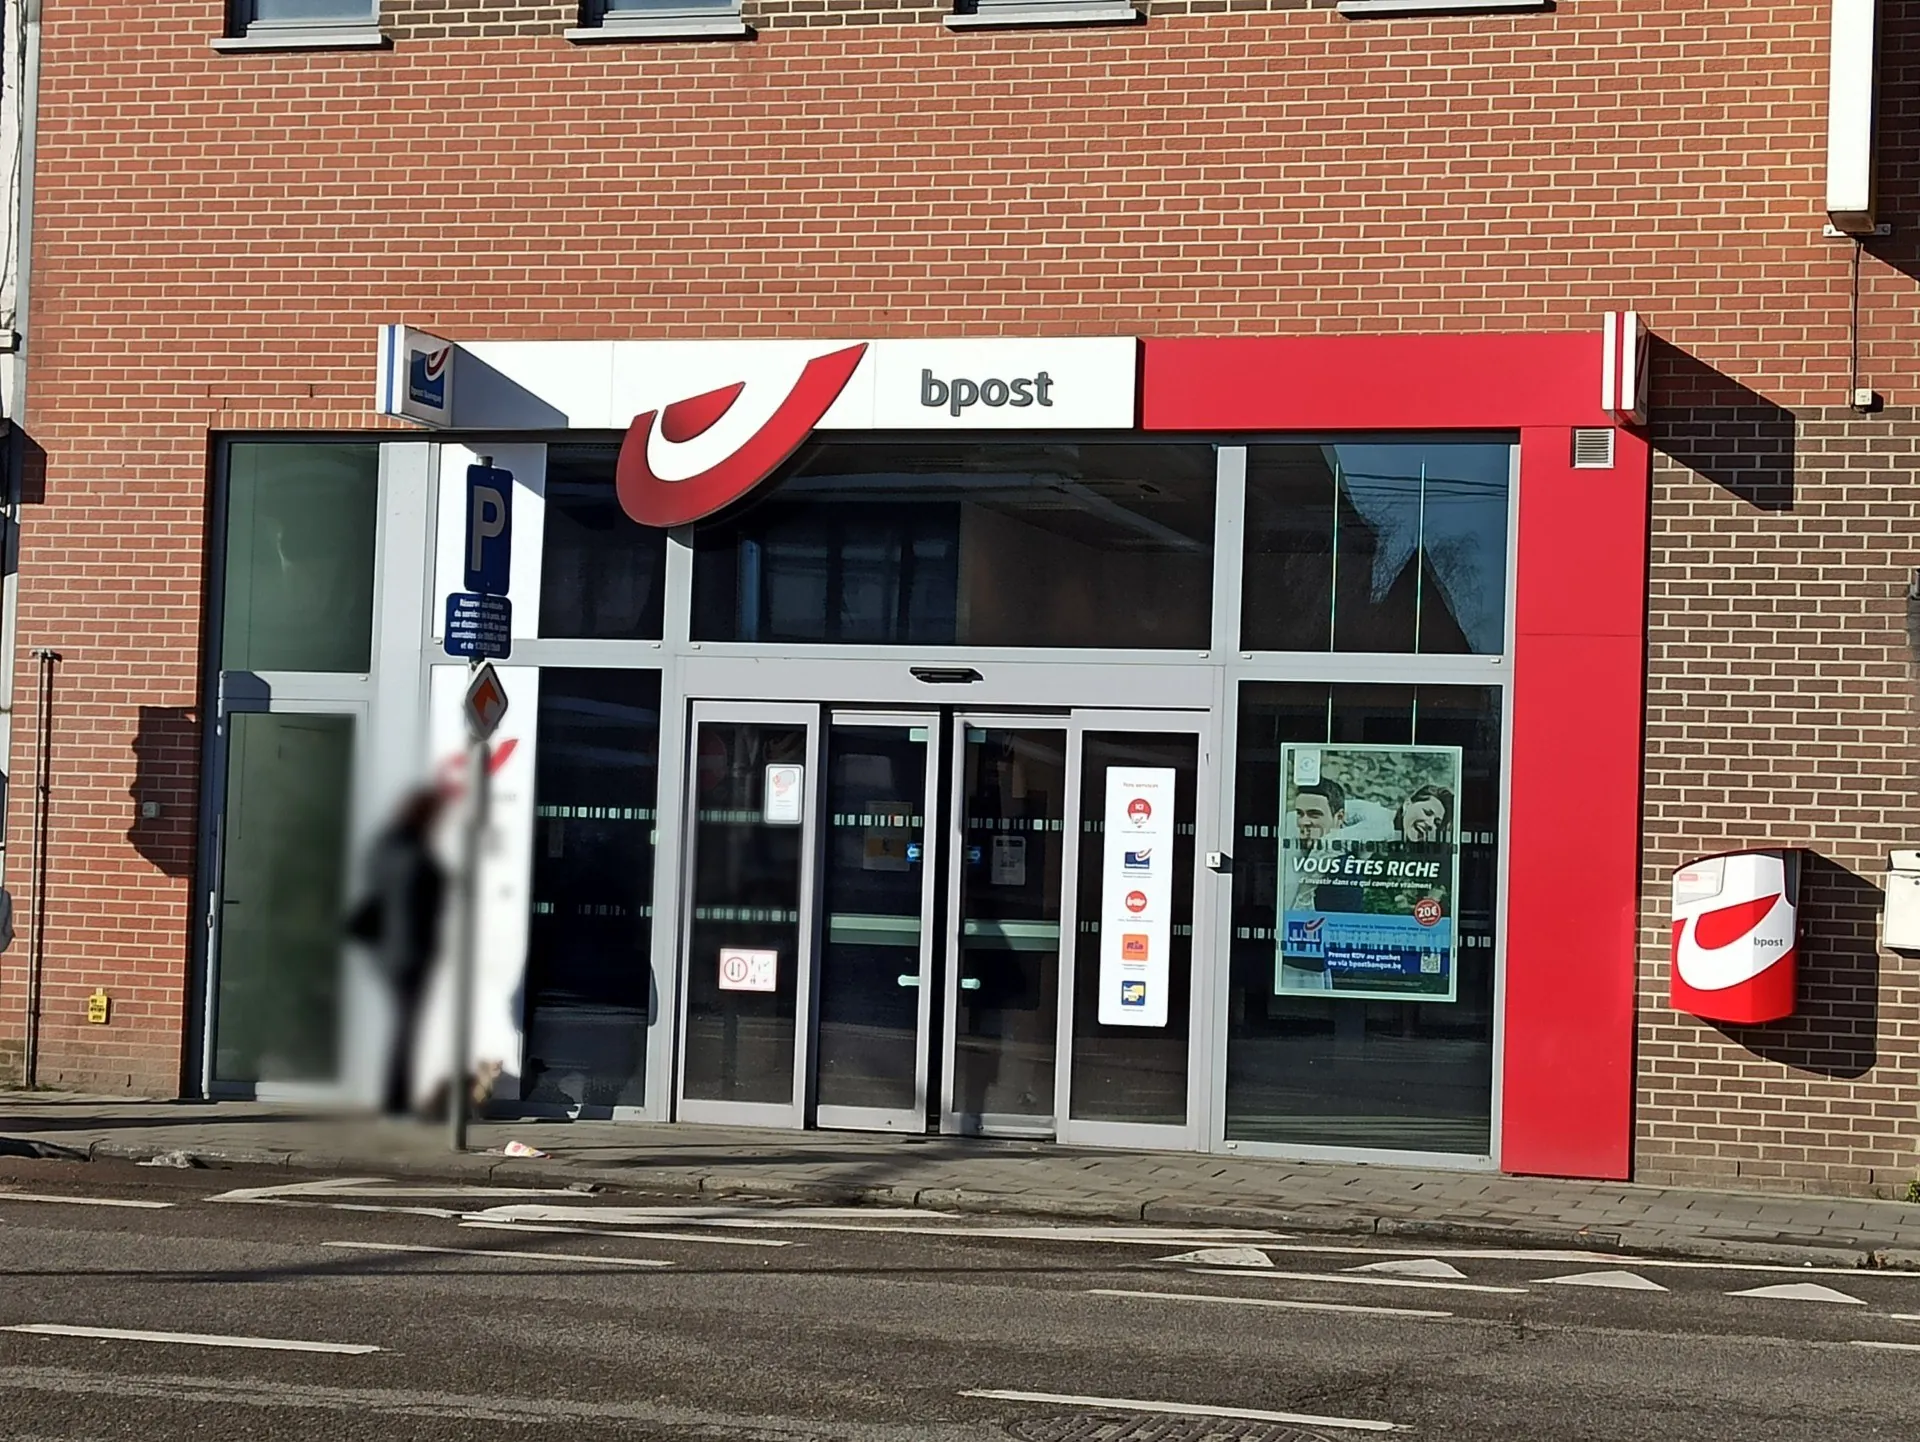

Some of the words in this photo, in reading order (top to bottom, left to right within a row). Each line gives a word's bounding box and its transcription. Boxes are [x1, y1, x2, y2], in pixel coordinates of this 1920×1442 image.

[921, 368, 1054, 417] bpost
[471, 485, 506, 572] P
[1293, 856, 1341, 873] VOUS
[1344, 855, 1384, 876] ÊTES
[1386, 861, 1440, 878] RICHE
[1417, 905, 1438, 918] 20€
[1753, 937, 1784, 947] bpost
